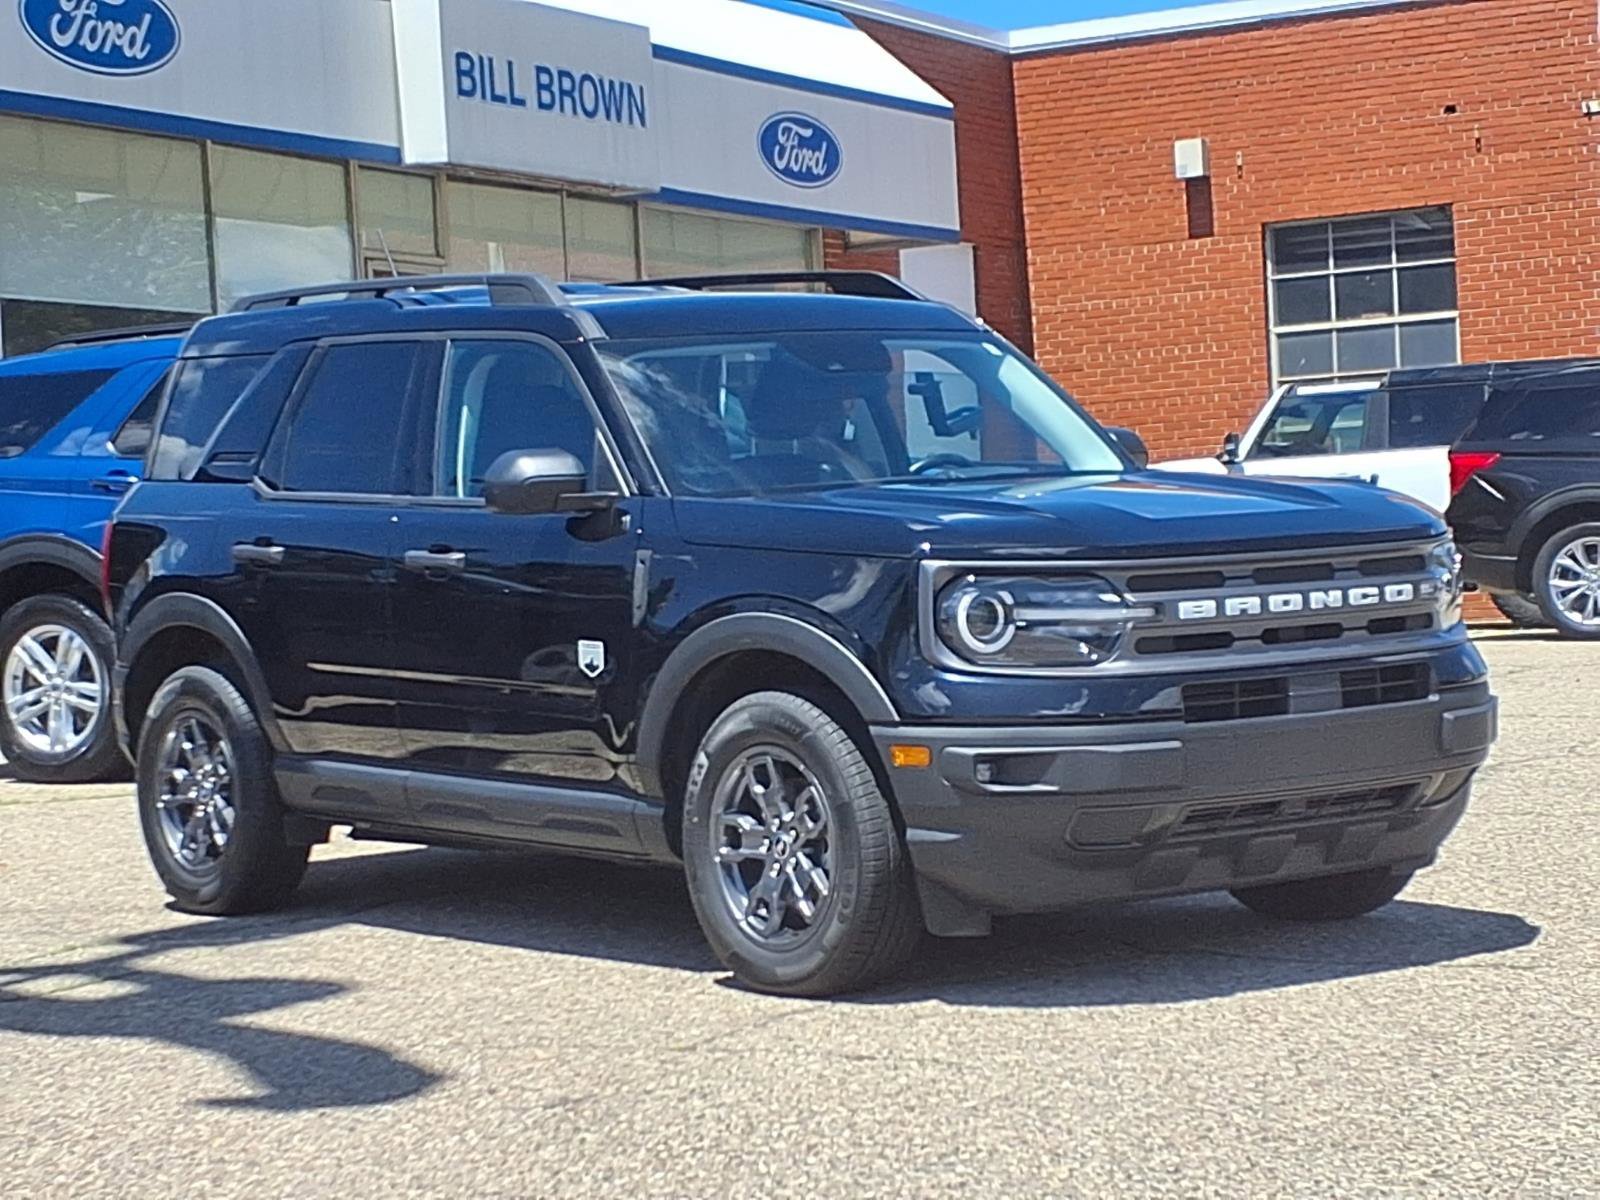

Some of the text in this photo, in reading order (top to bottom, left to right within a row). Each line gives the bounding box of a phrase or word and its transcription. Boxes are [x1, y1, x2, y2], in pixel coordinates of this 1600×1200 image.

[51, 0, 152, 60] Ford
[455, 51, 647, 128] BILL BROWN
[774, 121, 827, 176] Ford
[1178, 583, 1414, 619] BRONCO
